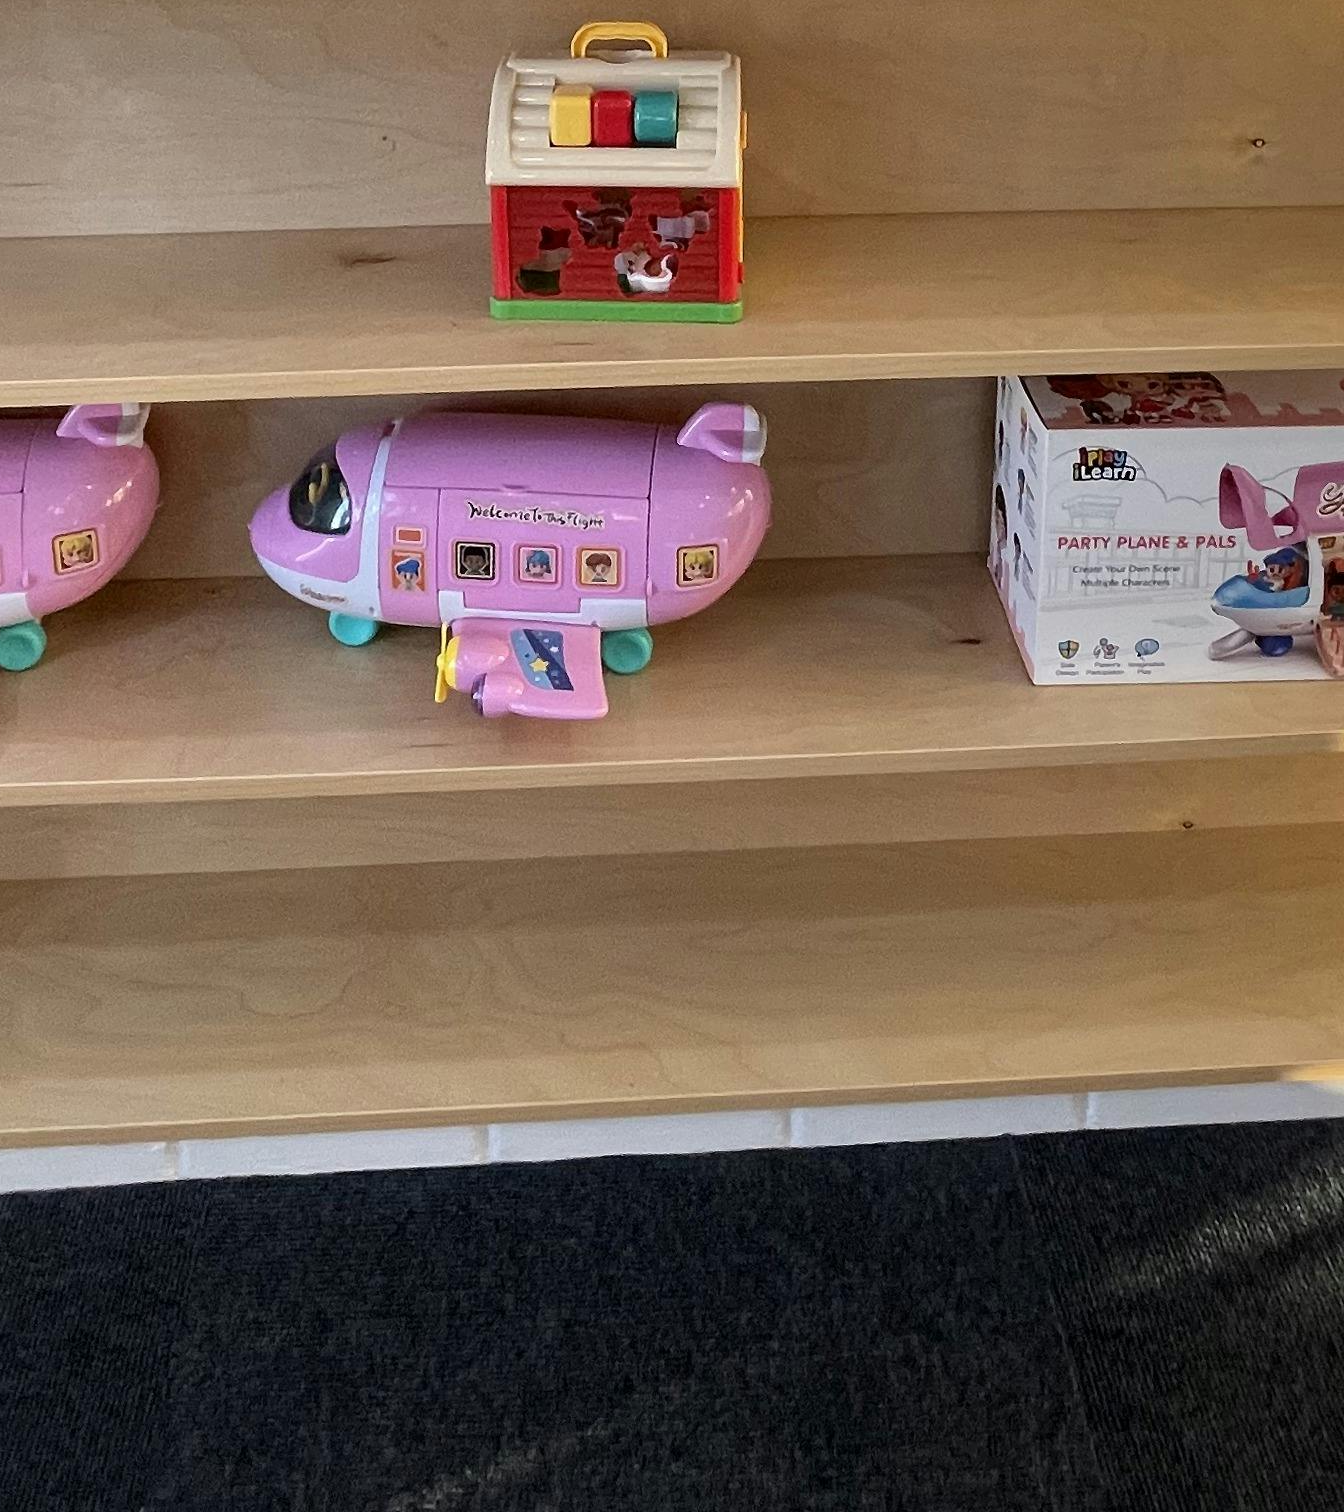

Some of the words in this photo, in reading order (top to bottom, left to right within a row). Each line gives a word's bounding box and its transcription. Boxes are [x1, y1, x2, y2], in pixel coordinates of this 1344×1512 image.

[1073, 463, 1136, 481] iLearn
[467, 501, 529, 520] Welcome
[1057, 535, 1110, 550] PARTY
[1117, 535, 1170, 550] PLANE
[1176, 535, 1189, 549] &
[1195, 534, 1237, 549] PALS
[1072, 565, 1103, 573] Create
[1106, 564, 1126, 573] Your
[1129, 564, 1150, 573] Own
[1153, 564, 1181, 573] Scene
